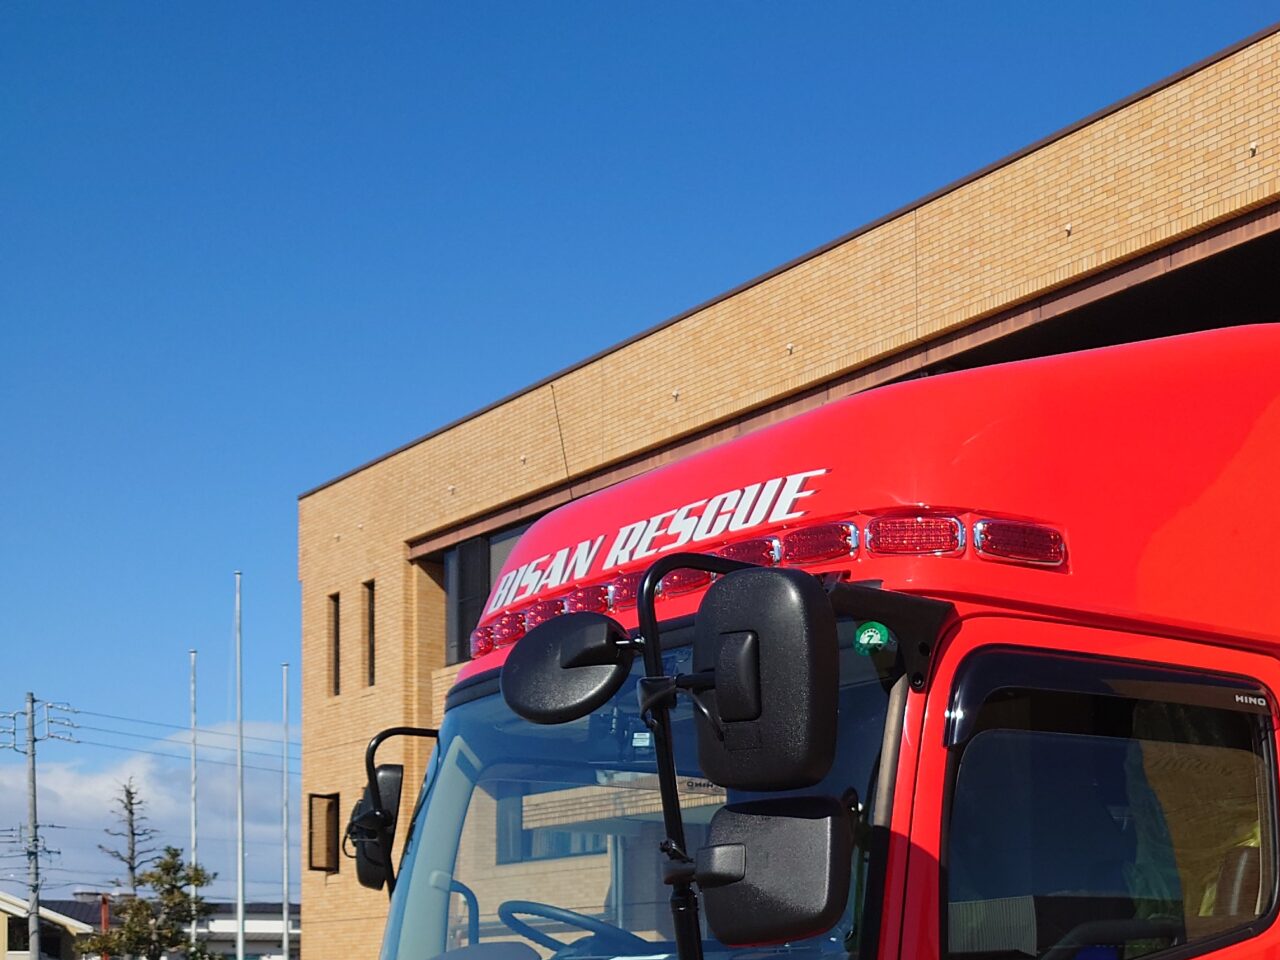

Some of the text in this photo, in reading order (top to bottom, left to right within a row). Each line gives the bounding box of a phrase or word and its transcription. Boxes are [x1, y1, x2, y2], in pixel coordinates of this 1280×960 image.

[486, 468, 830, 616] BISAN RESCUE
[1235, 694, 1267, 706] HINO
